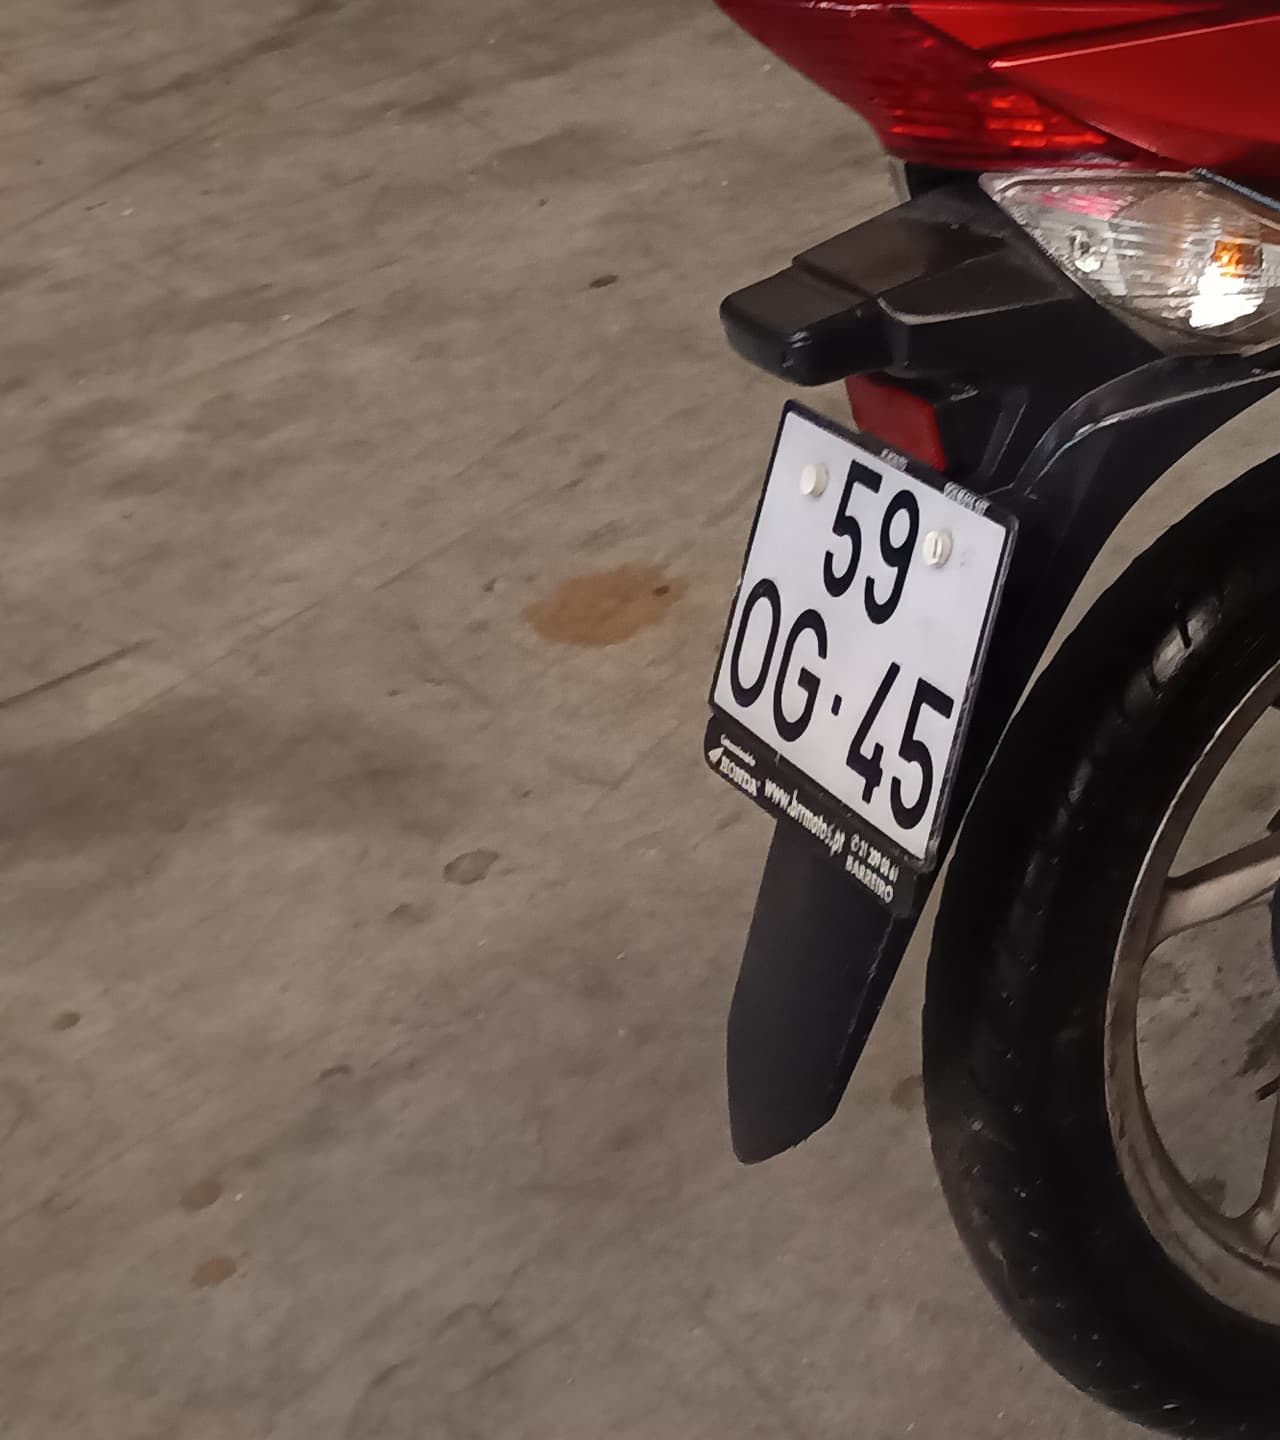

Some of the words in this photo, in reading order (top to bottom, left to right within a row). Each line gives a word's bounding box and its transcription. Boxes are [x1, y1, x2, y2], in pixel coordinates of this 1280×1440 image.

[823, 458, 920, 625] 59
[719, 755, 757, 797] HONDA
[845, 854, 894, 904] BARREIRO
